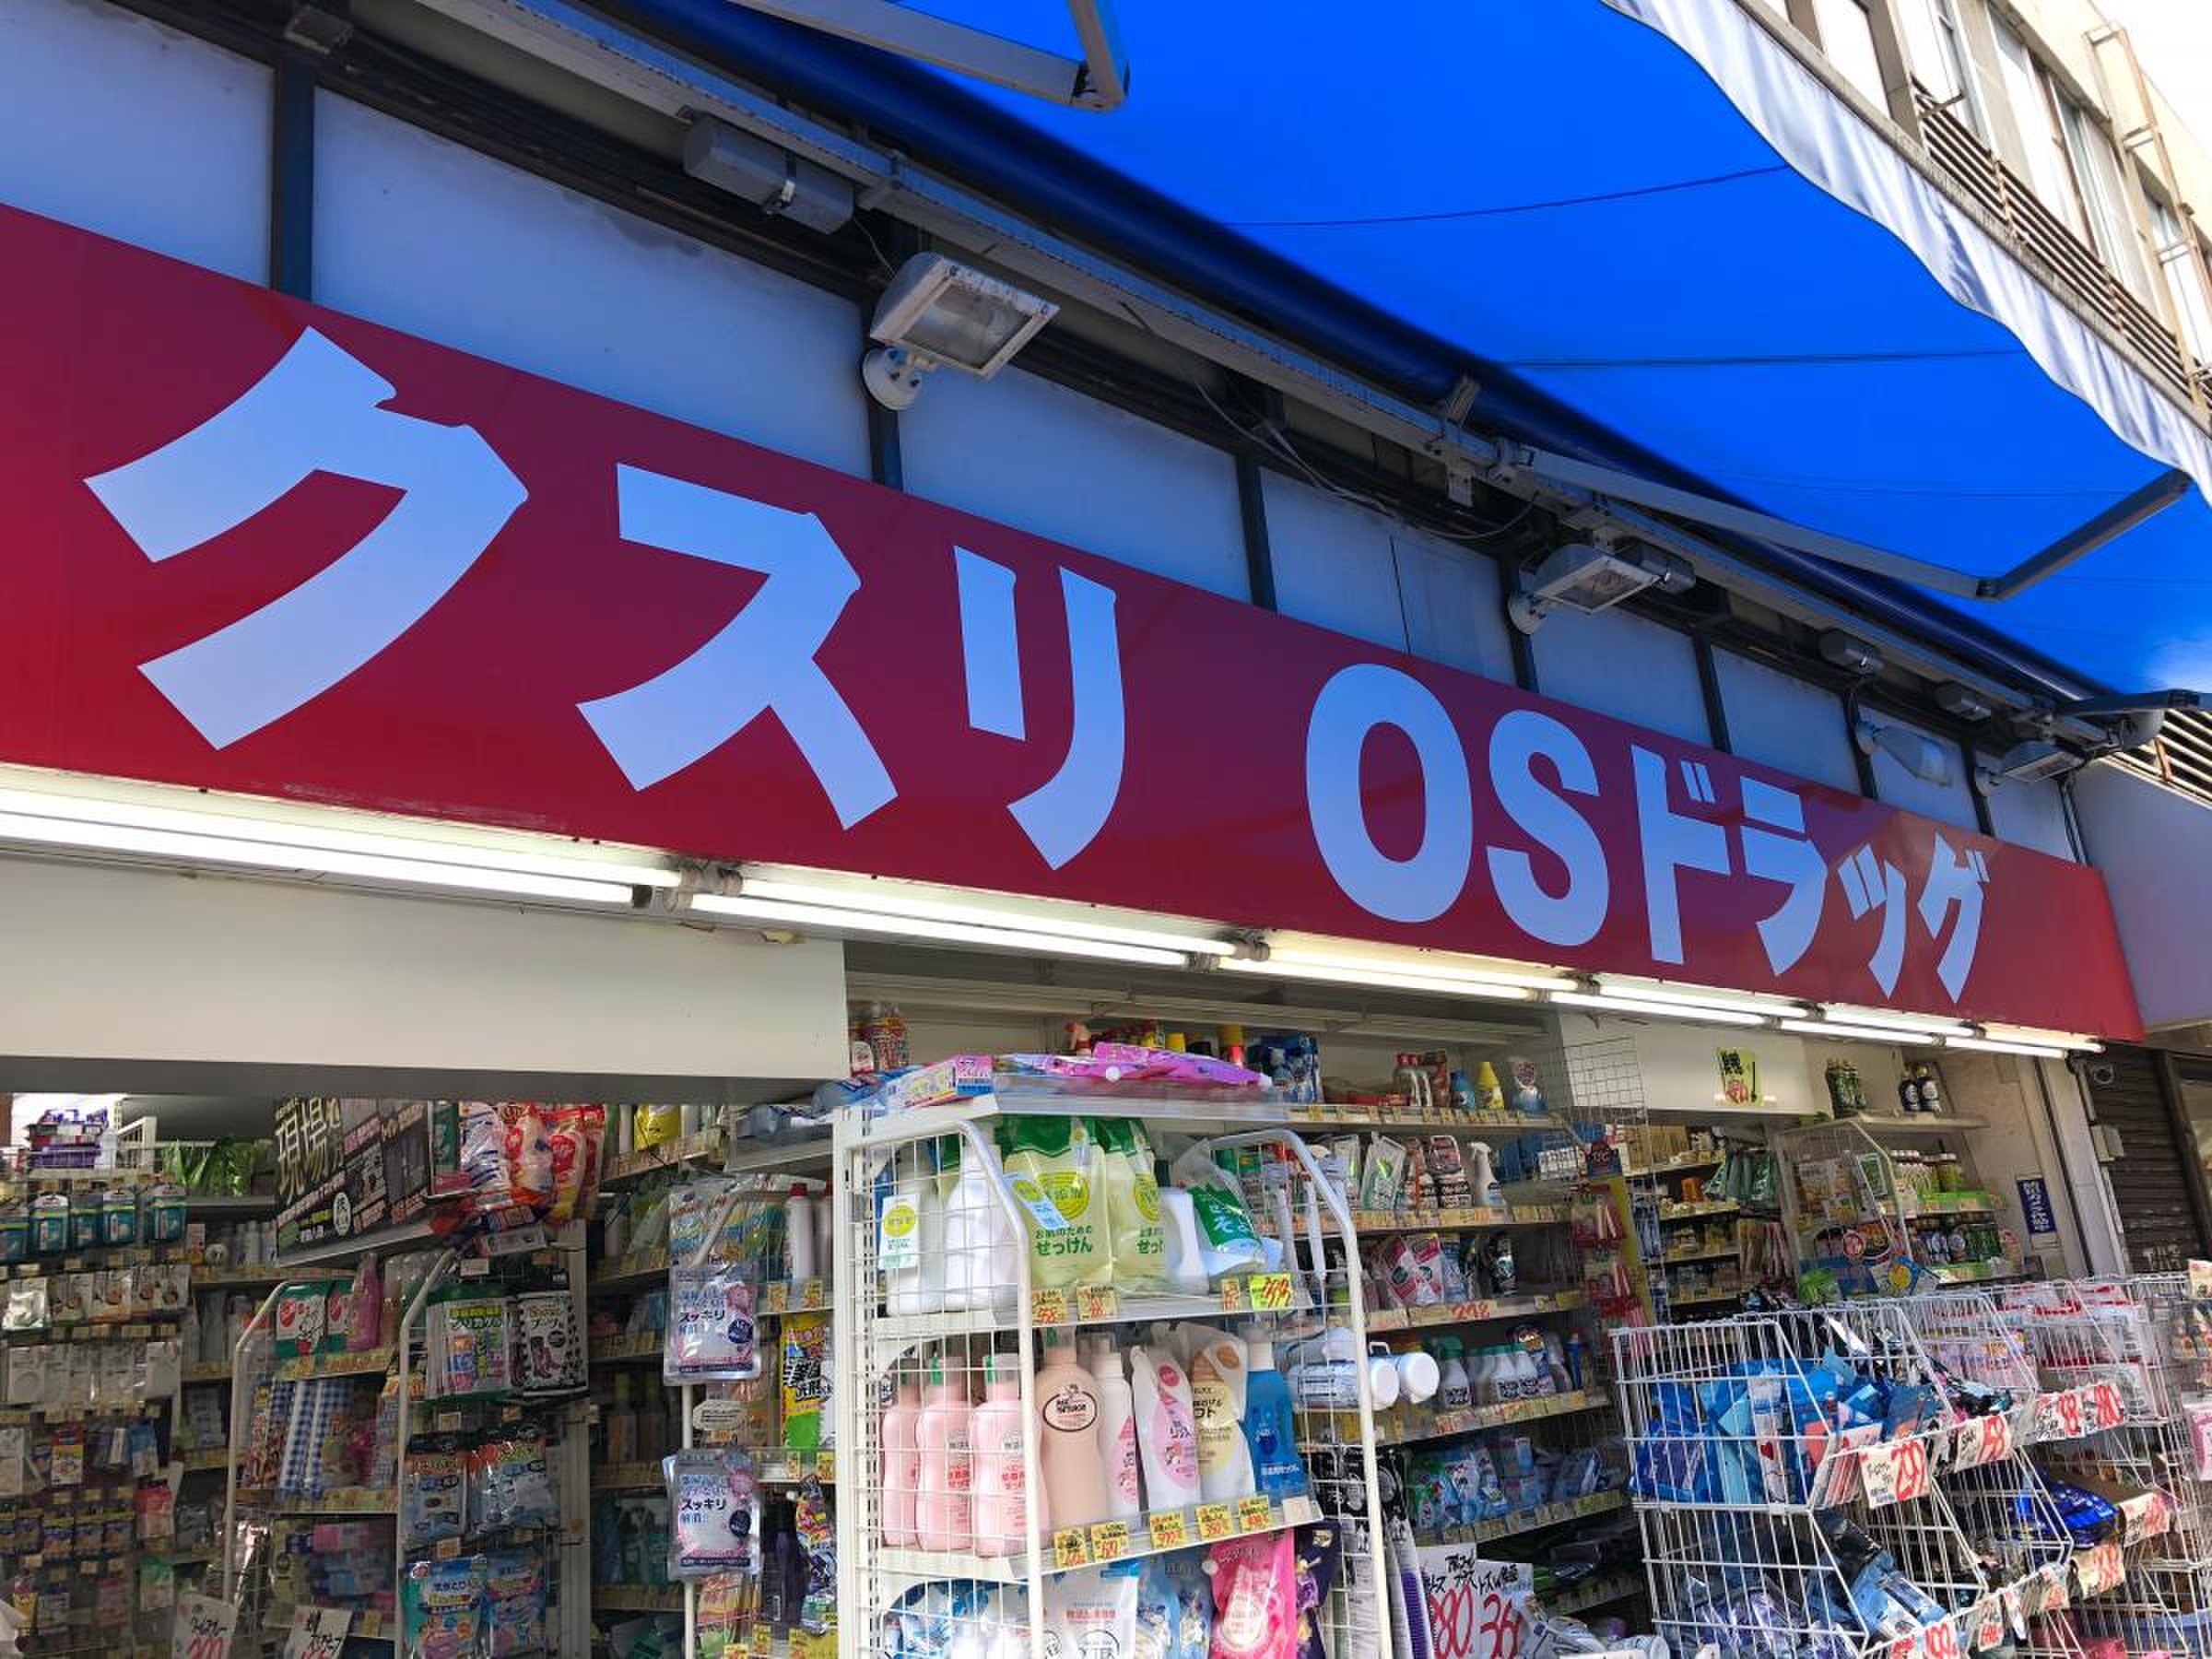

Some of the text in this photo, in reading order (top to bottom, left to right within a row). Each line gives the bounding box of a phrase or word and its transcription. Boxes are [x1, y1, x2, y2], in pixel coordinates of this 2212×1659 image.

[85, 326, 1991, 1004] クスリ OSドラッグ
[1035, 1238, 1092, 1256] せっけん
[681, 1498, 727, 1512] スッキリ
